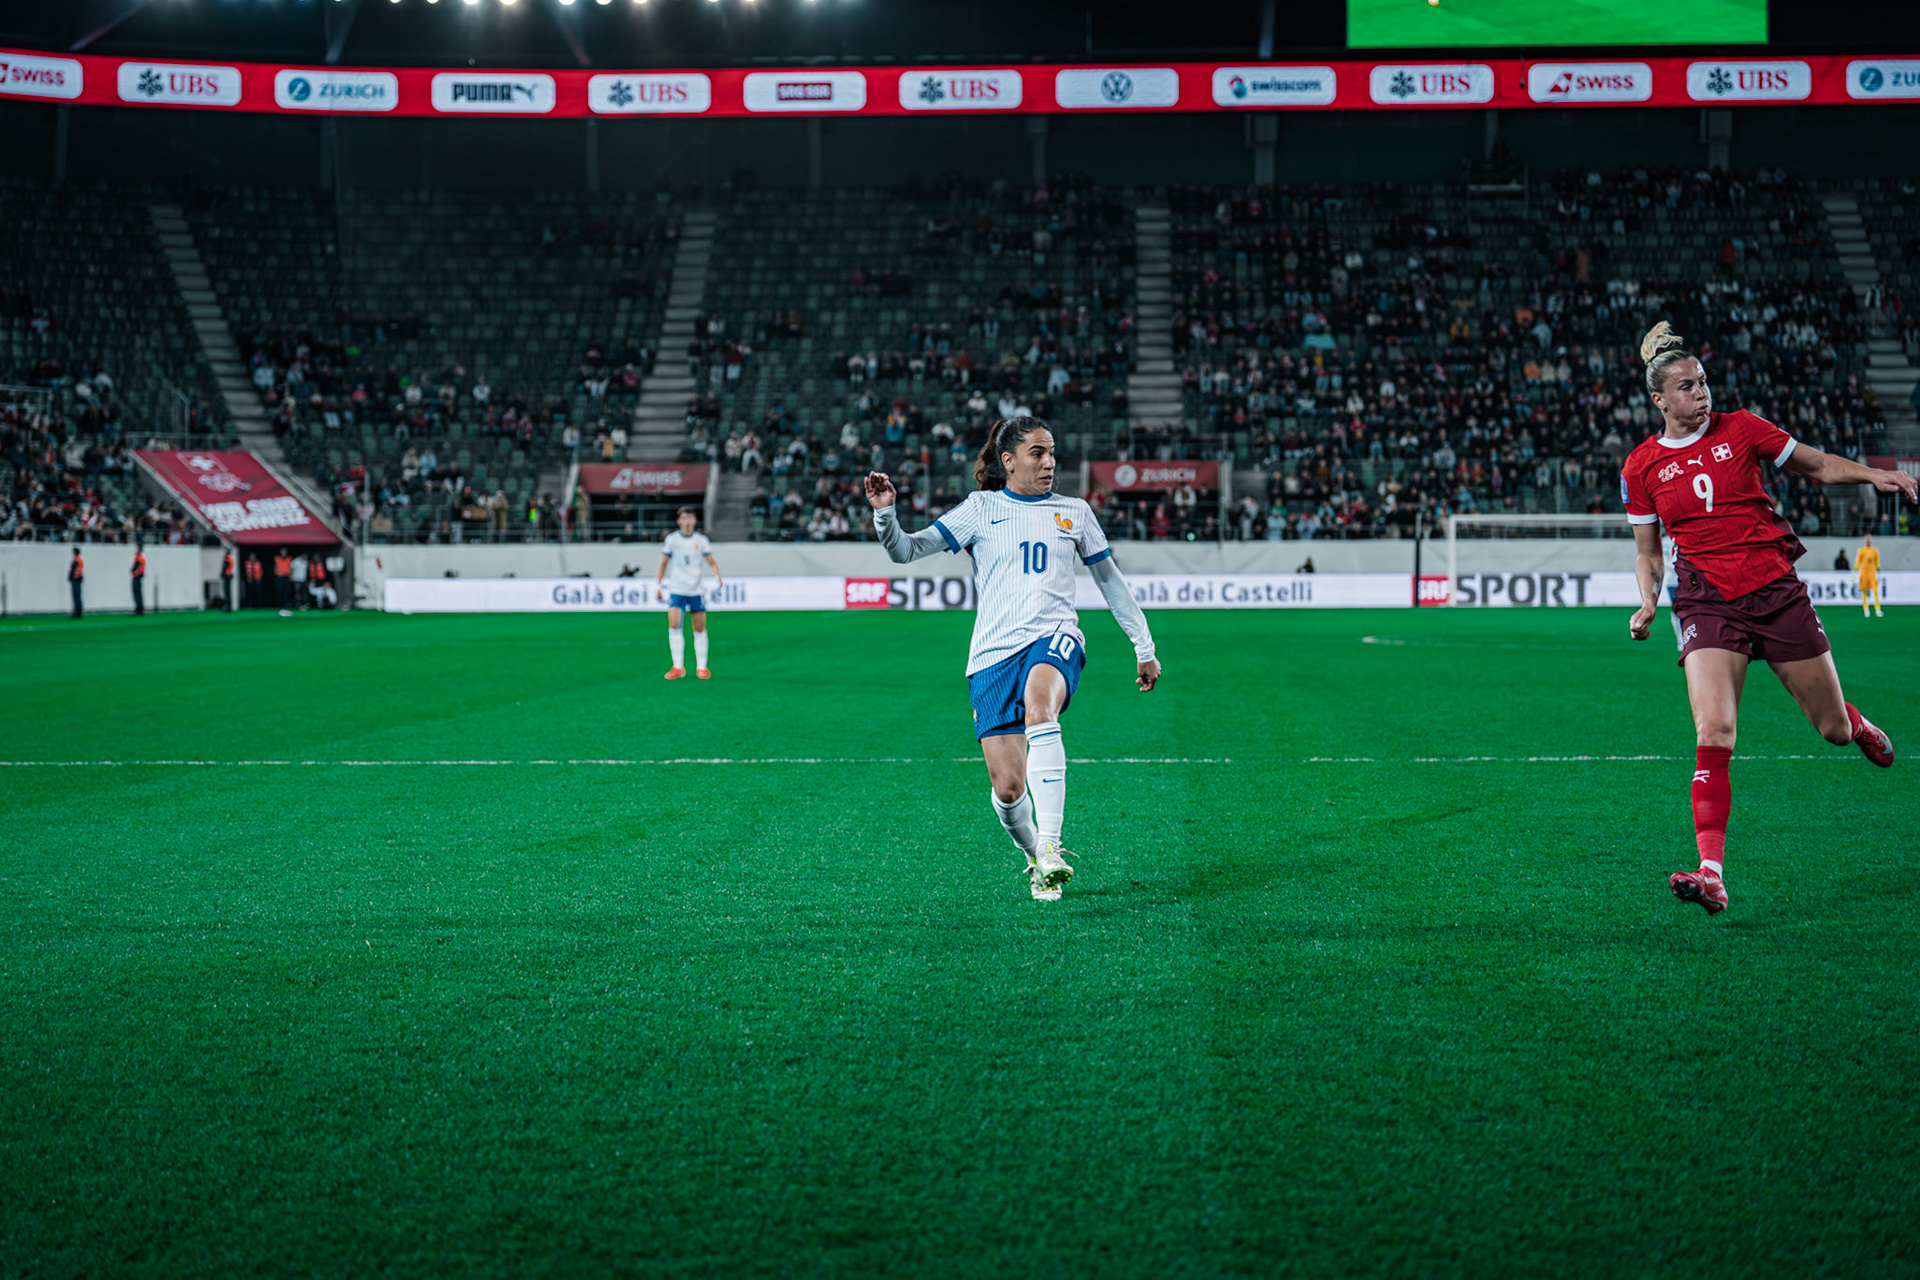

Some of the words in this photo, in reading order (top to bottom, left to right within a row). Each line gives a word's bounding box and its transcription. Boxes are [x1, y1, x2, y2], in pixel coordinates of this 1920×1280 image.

[12, 67, 66, 86] SWISS
[169, 73, 219, 96] UBS
[1421, 73, 1470, 94] UBS
[1575, 74, 1634, 90] SWISS
[1738, 70, 1788, 91] UBS
[1891, 71, 1920, 87] ZU
[318, 83, 386, 99] ZURICH
[453, 84, 512, 103] PUMA
[640, 82, 688, 103] UBS
[949, 79, 999, 100] UBS
[632, 469, 683, 487] SWISS
[1141, 468, 1196, 482] ZURICH
[1692, 473, 1714, 512] 9
[1019, 541, 1048, 575] 10
[552, 582, 604, 605] Galà
[612, 584, 648, 605] dei
[847, 582, 886, 603] SRF
[890, 578, 978, 608] SPO
[1134, 579, 1169, 602] alà
[1177, 581, 1213, 602] dei
[1222, 581, 1312, 602] Castelli
[1456, 575, 1591, 607] SPORT
[1049, 632, 1076, 661] 10
